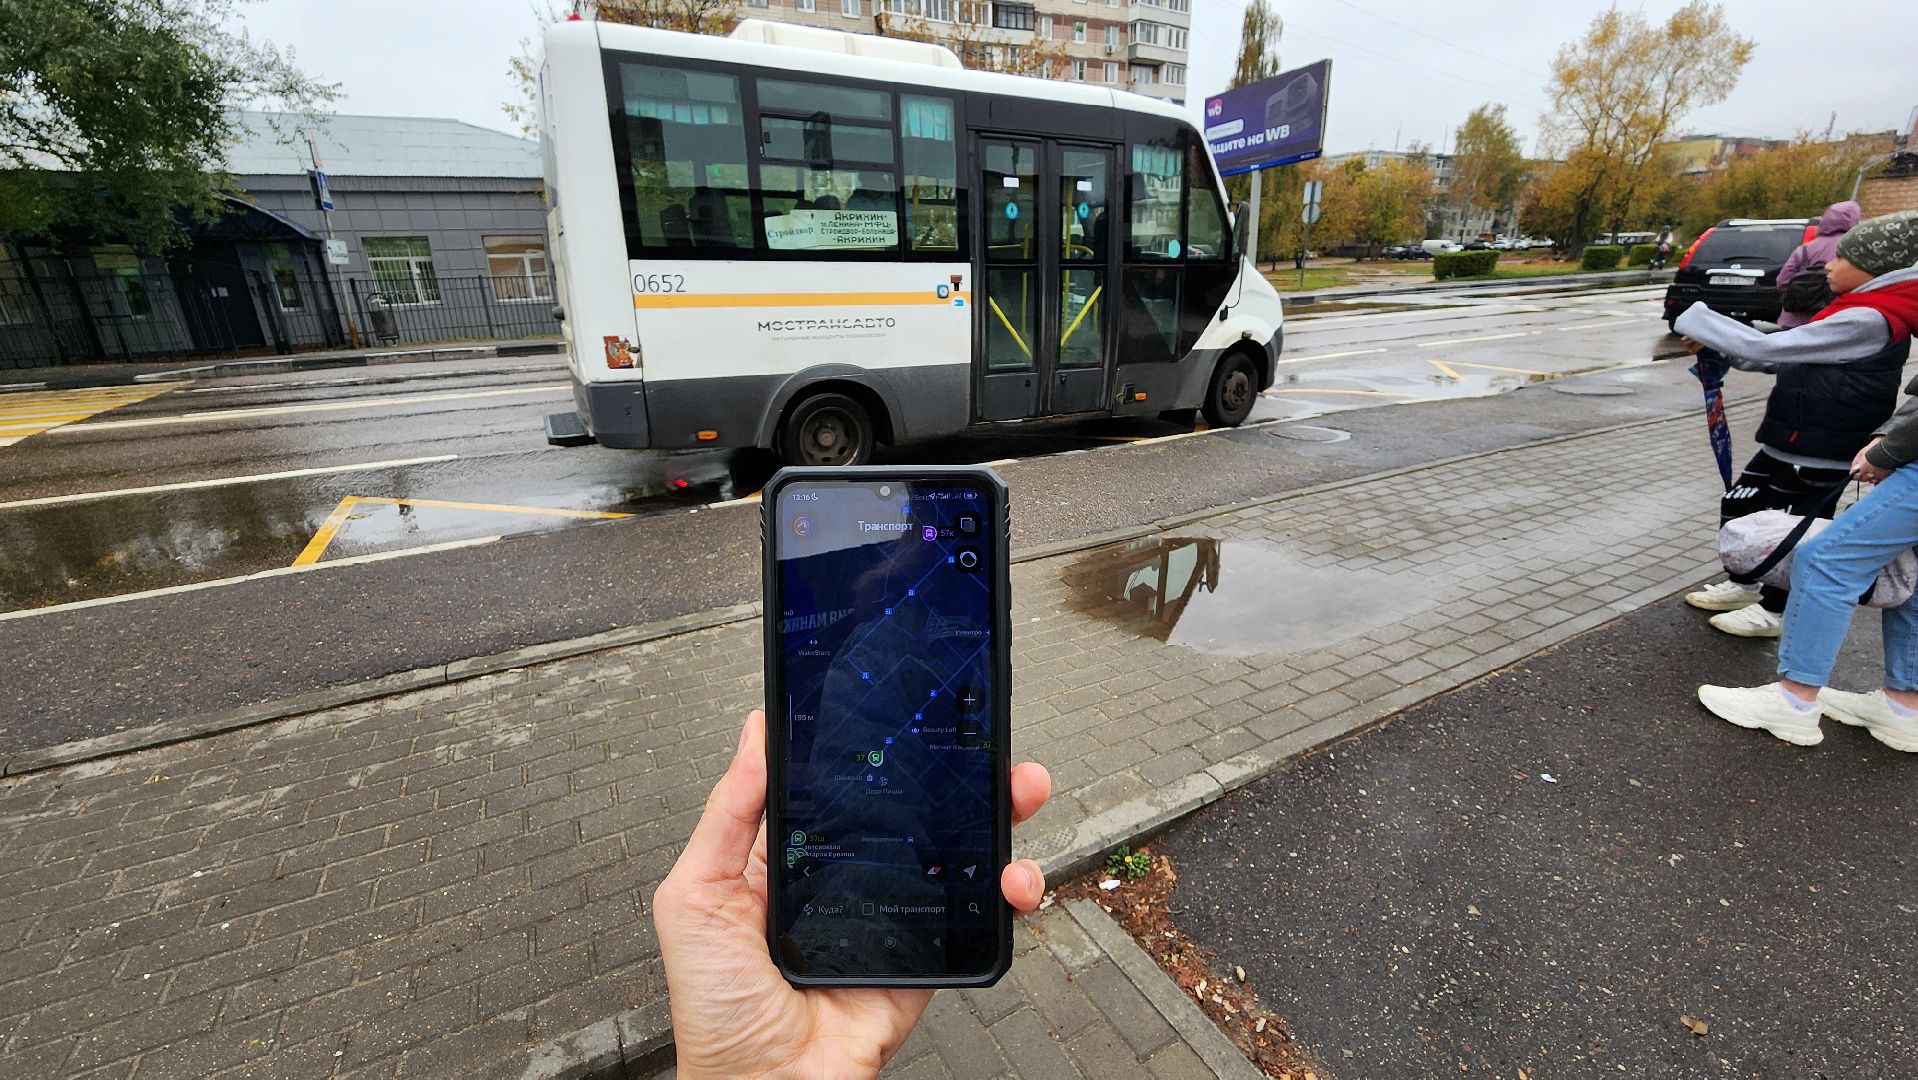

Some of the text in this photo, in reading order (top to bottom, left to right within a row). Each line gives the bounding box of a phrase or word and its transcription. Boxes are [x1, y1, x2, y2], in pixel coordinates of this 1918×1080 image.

[1208, 104, 1222, 116] wb
[1247, 132, 1264, 146] на
[1265, 124, 1290, 142] WB
[634, 274, 686, 293] 0652
[758, 318, 896, 332] МОСТРАНСАВТО
[858, 520, 913, 531] Транспорт
[818, 904, 946, 915] Куда? Мой транспорт
